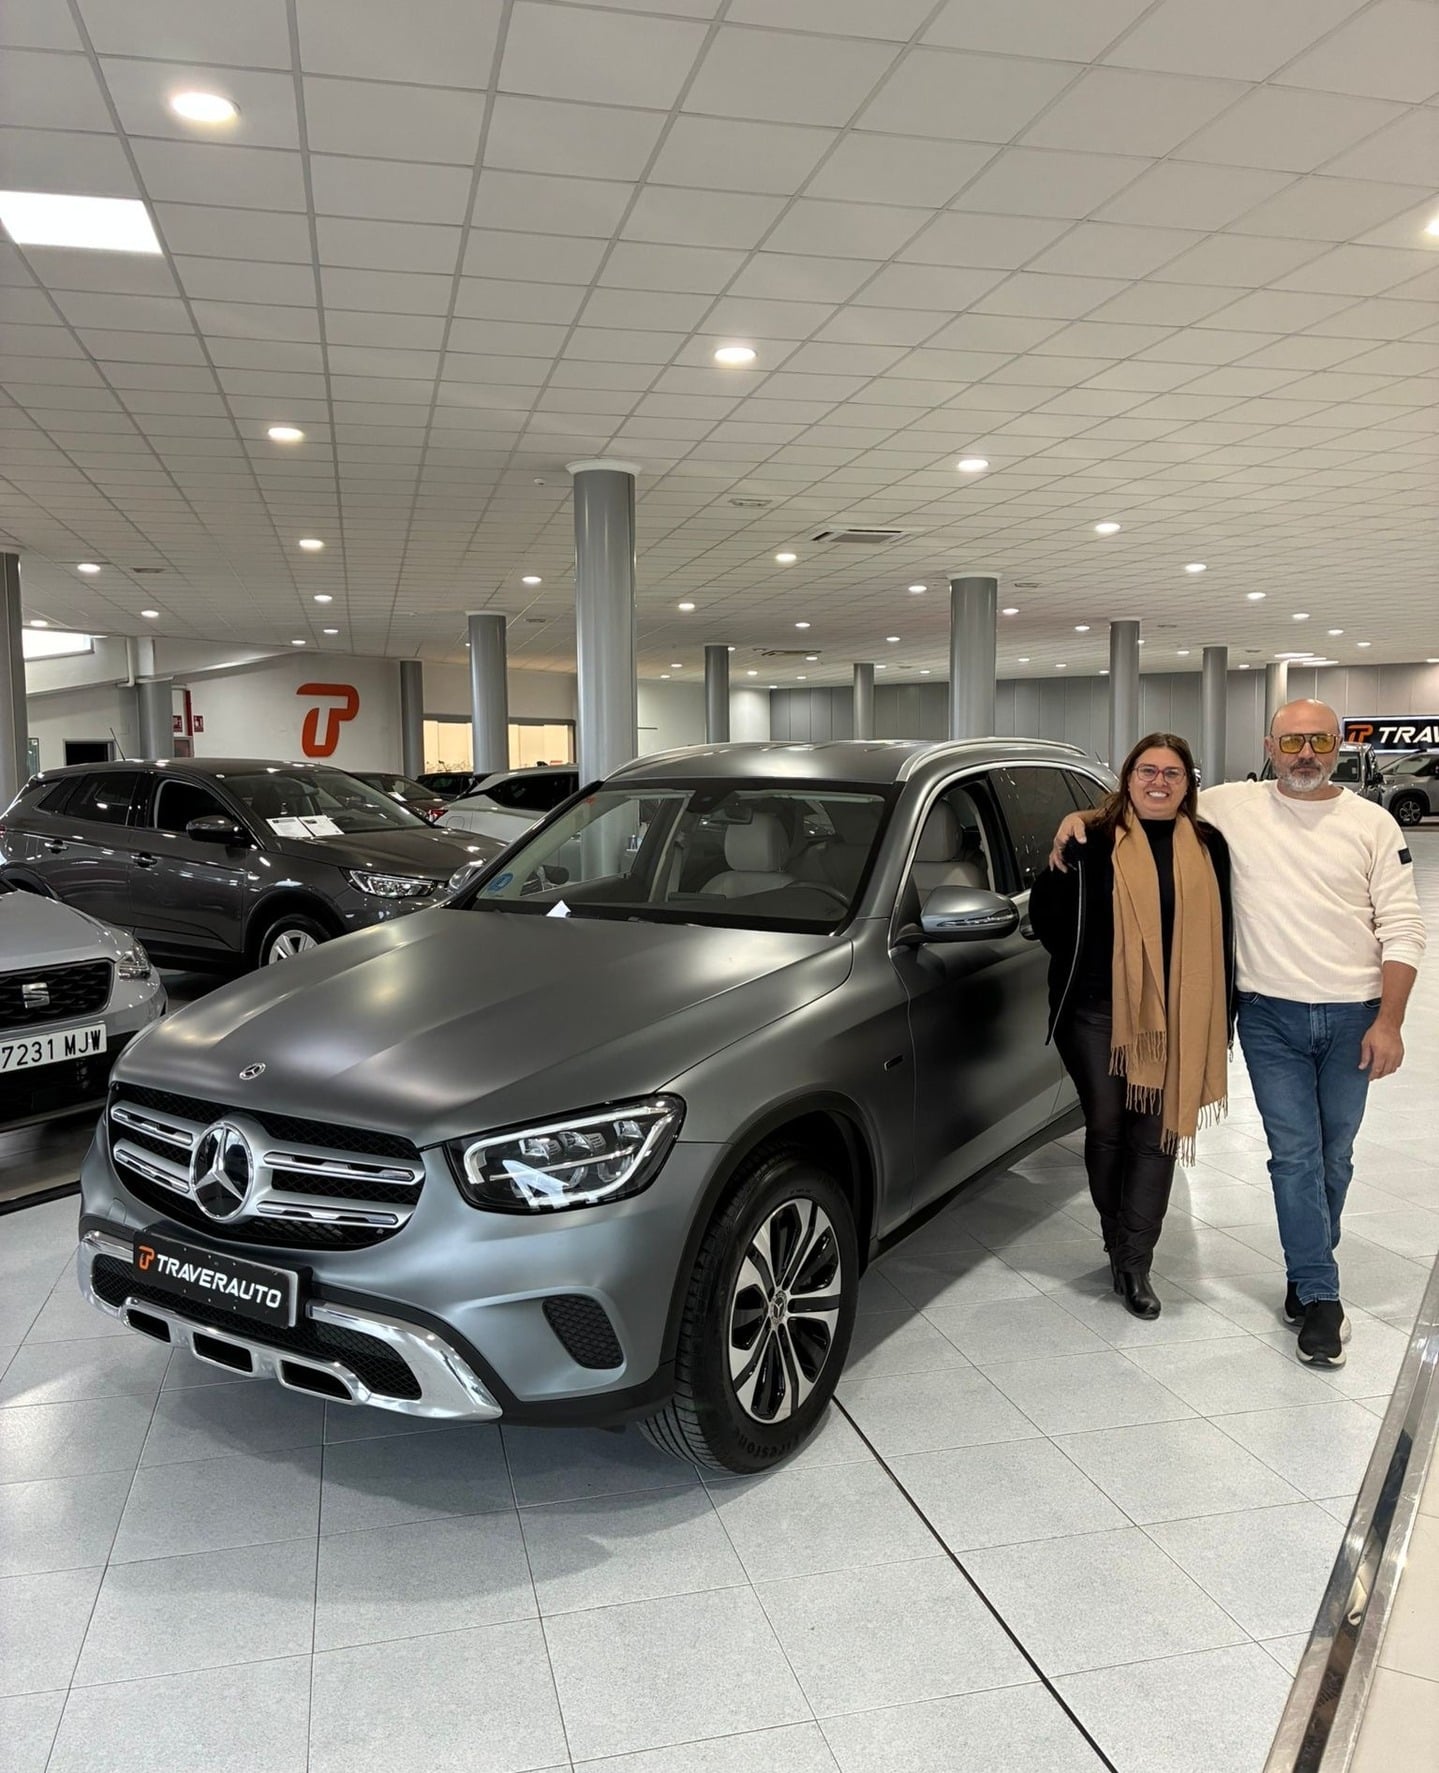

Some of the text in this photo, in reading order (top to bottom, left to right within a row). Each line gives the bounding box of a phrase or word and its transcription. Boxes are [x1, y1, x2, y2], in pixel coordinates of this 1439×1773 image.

[1378, 726, 1439, 744] TRA
[2, 1029, 101, 1069] 7231 MJW
[156, 1253, 282, 1309] TRAVERAUTO
